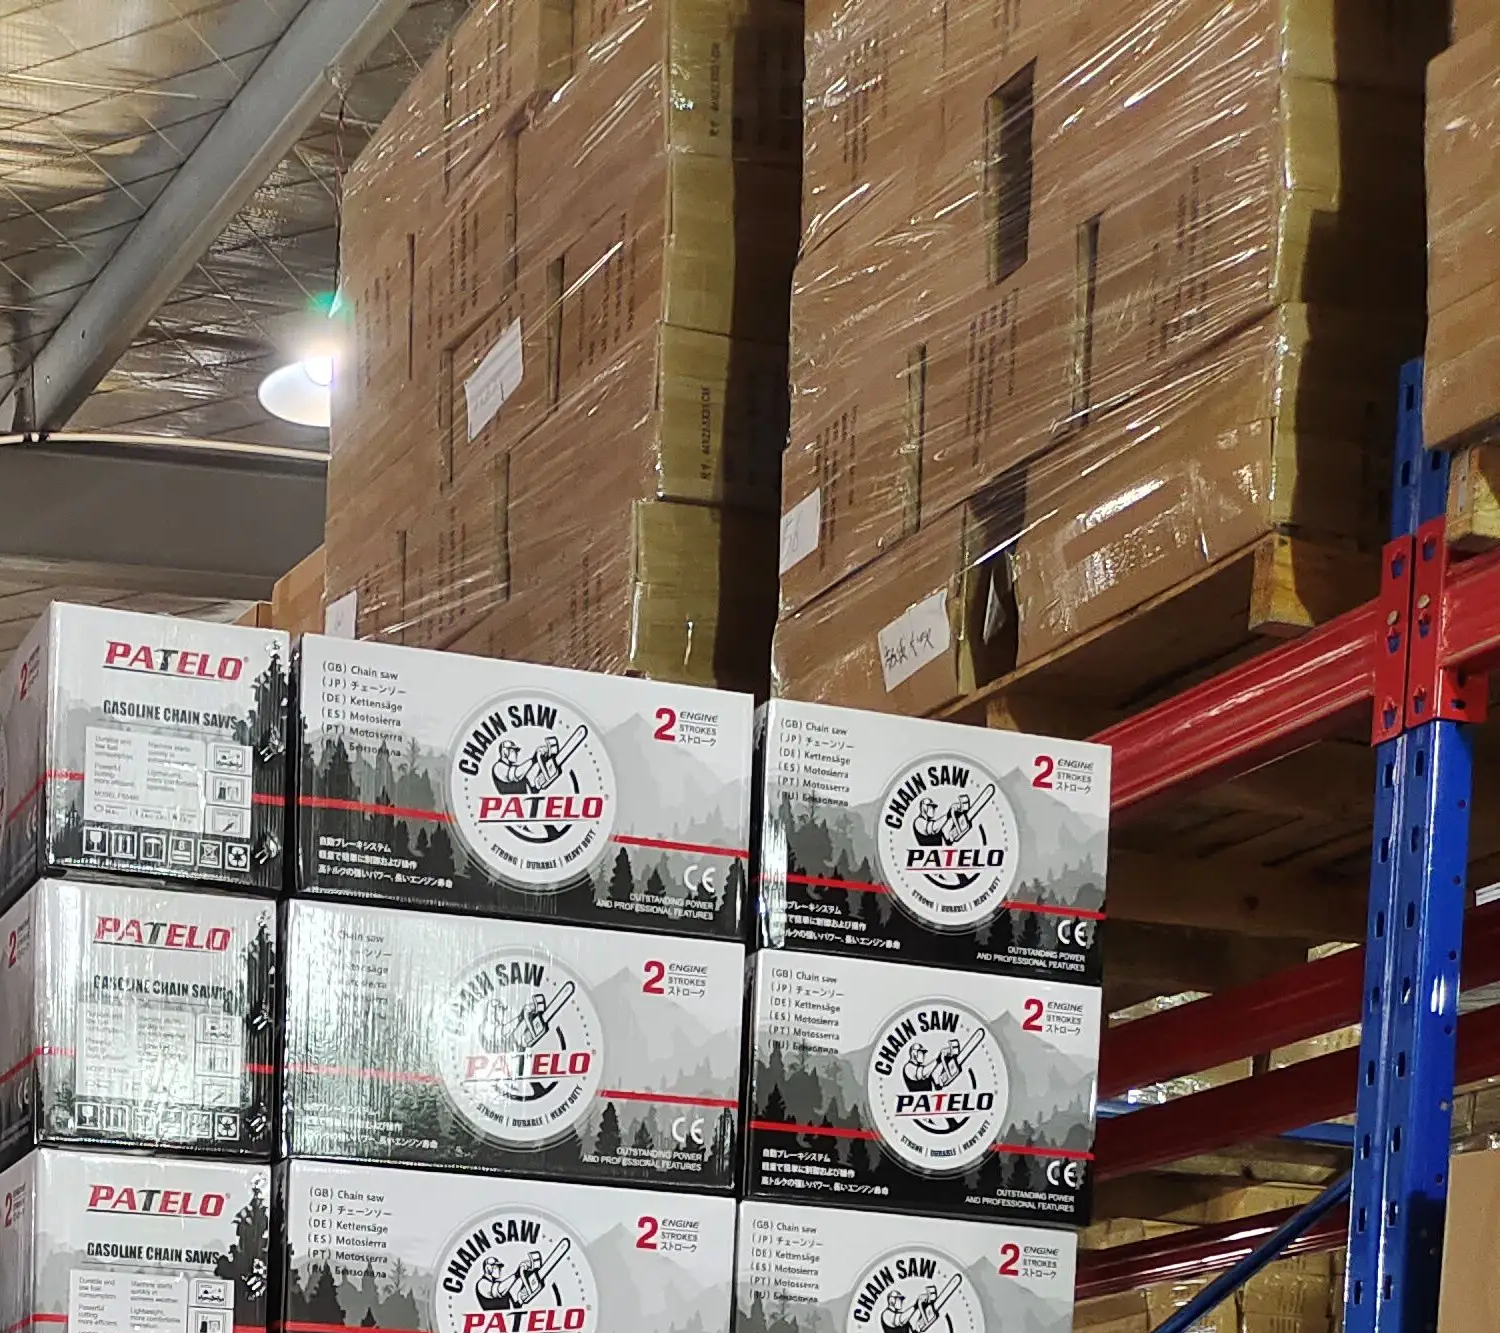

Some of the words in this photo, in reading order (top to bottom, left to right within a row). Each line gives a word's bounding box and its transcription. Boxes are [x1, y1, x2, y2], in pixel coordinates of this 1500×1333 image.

[105, 640, 243, 681] PATELO
[350, 664, 378, 677] Chain
[380, 671, 399, 679] saw
[351, 680, 407, 697] チェーンソー
[103, 699, 161, 721] GASOLINE
[163, 708, 201, 725] CHAIN
[203, 712, 238, 730] SAWS
[349, 710, 402, 726] Motosierra
[654, 705, 677, 741] 2
[679, 710, 718, 723] ENGINE
[458, 711, 508, 775] CHAIN
[508, 703, 557, 730] SAW
[679, 734, 716, 746] ストローク
[1032, 755, 1054, 789] 2
[885, 773, 927, 829] CHAIN
[927, 765, 970, 788] SAW
[1056, 781, 1091, 794] ストローク
[479, 796, 604, 819] PATELO
[906, 849, 1004, 868] PATELO
[683, 863, 716, 893] CE
[595, 898, 613, 908] AND
[614, 900, 673, 915] PROFESSIONAL
[674, 908, 714, 920] FEATURES
[629, 892, 684, 906] OUTSTANDING
[685, 899, 714, 909] POWER
[94, 916, 232, 951] PATELO
[1057, 918, 1088, 946] CE
[8, 930, 17, 969] 2
[495, 961, 545, 987] SAW
[642, 959, 666, 994] 2
[668, 963, 708, 974] ENGINE
[152, 980, 190, 996] CHAIN
[667, 986, 706, 997] ストローク
[1022, 998, 1044, 1031] 2
[1046, 1024, 1081, 1035] ストローク
[875, 1019, 917, 1075] CHAIN
[918, 1010, 960, 1032] SAW
[896, 1093, 994, 1112] PATELO
[671, 1116, 705, 1144] CE
[582, 1154, 599, 1163] AND
[600, 1155, 661, 1168] PROFESSIONAL
[662, 1161, 702, 1171] FEATURES
[616, 1146, 672, 1158] OUTSTANDING
[673, 1152, 702, 1160] POWER
[1046, 1159, 1077, 1187] CE
[88, 1184, 225, 1217] PATELO
[337, 1189, 364, 1200] Chain
[366, 1194, 385, 1202] saw
[338, 1205, 393, 1219] チェーンソー
[335, 1235, 387, 1248] Motosierra
[636, 1215, 659, 1249] 2
[661, 1218, 700, 1229] ENGINE
[87, 1242, 143, 1259] GASOLINE
[146, 1247, 182, 1263] CHAIN
[185, 1250, 220, 1265] SAWS
[443, 1229, 492, 1293] CHAIN
[492, 1219, 541, 1244] SAW
[660, 1242, 698, 1252] ストローク
[999, 1243, 1021, 1275] 2
[1022, 1268, 1057, 1278] ストローク
[854, 1266, 894, 1322] CHAIN
[895, 1257, 937, 1278] SAW
[462, 1308, 585, 1333] PATELO
